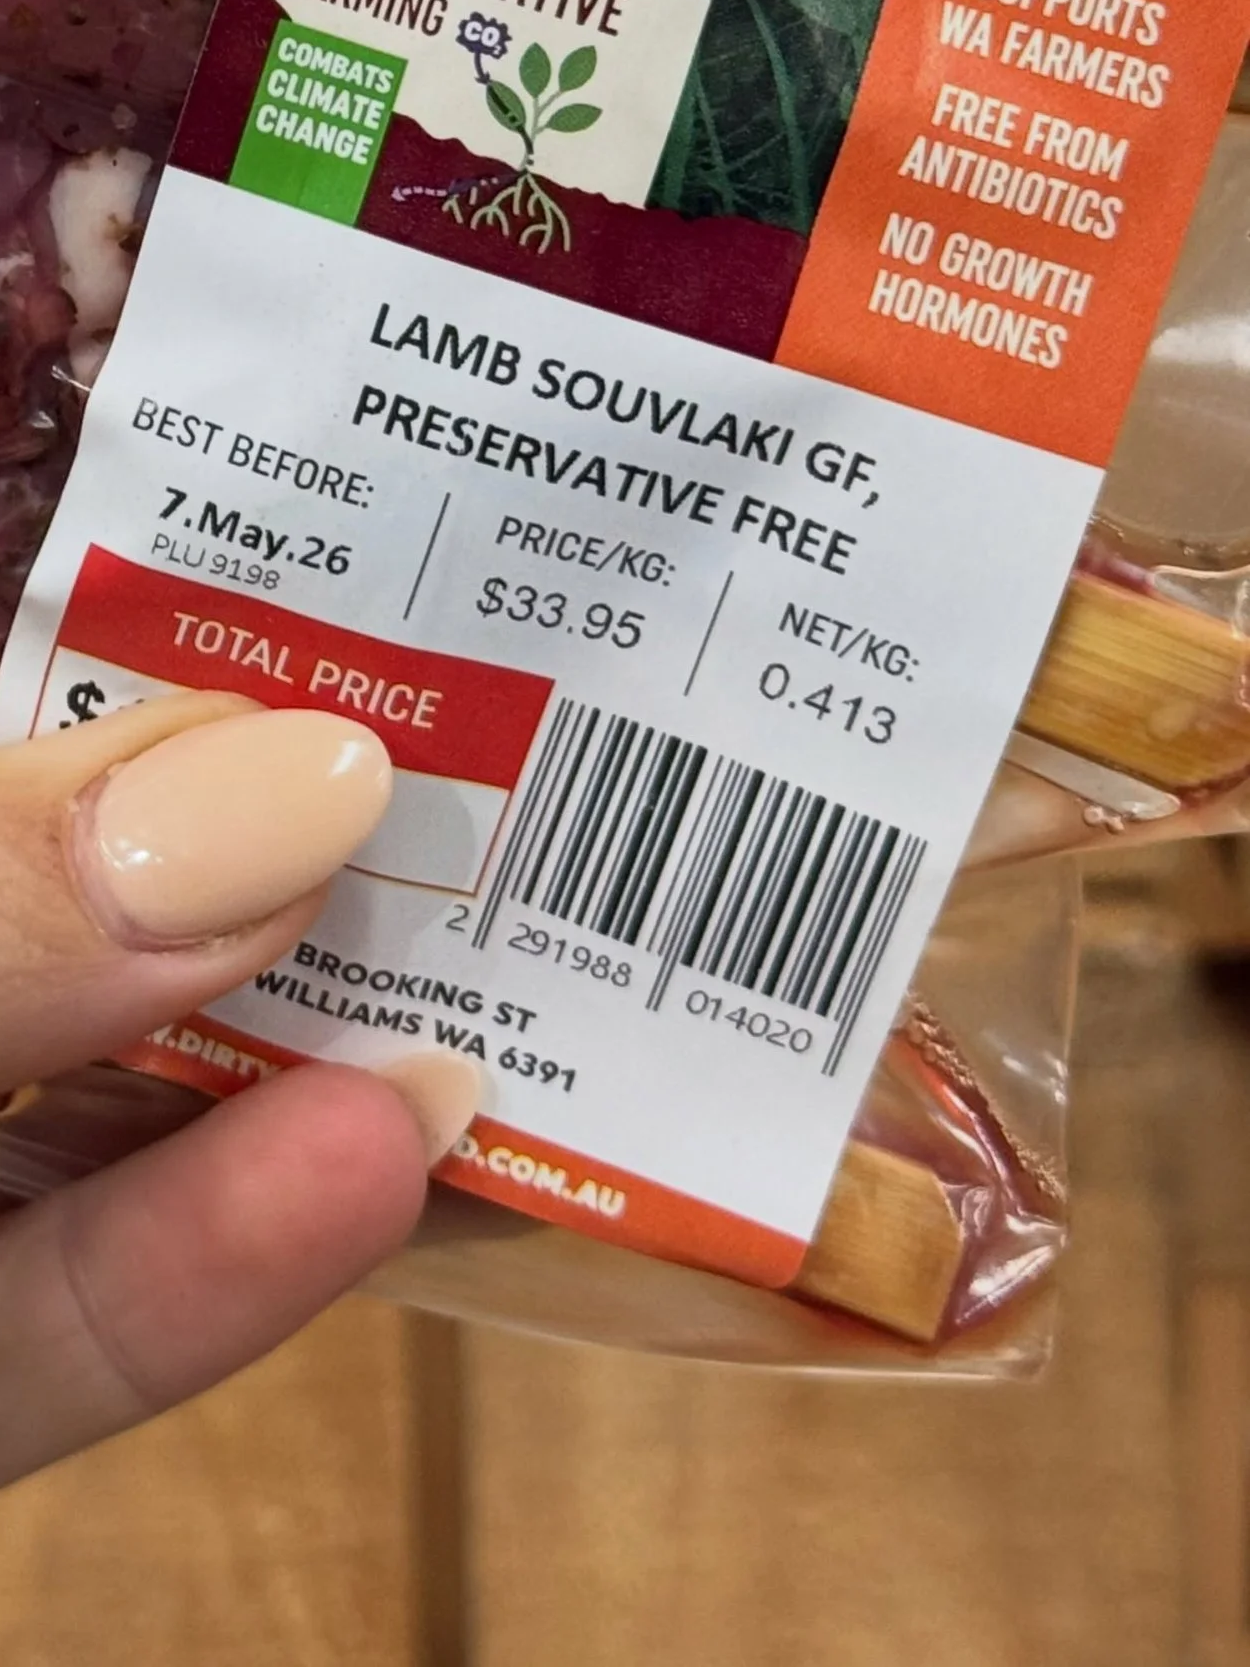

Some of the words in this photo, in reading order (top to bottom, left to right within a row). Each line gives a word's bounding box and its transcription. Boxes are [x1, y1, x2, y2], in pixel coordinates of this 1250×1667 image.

[267, 69, 385, 129] CLIMATE
[278, 37, 394, 94] COMBATS
[939, 0, 993, 58] WA
[1000, 22, 1172, 109] FARMERS
[255, 105, 374, 166] CHANGE
[931, 83, 1021, 149] FREE
[1023, 112, 1129, 181] FROM
[898, 136, 1124, 240] ANTIBIOTICS
[878, 212, 935, 266] NO
[939, 232, 1093, 317] GROWTH
[868, 270, 1068, 369] HORMONES
[132, 397, 223, 456] BEST
[227, 432, 375, 509] BEFORE:
[370, 302, 522, 387] LAMB
[531, 359, 795, 467] SOUVLAKI
[805, 440, 880, 509] GF,
[352, 384, 725, 525] PRESERVATIVE
[731, 494, 857, 576] FREE
[151, 533, 206, 569] PLU
[209, 551, 281, 591] 9198
[157, 486, 353, 577] 7.May.26
[495, 515, 676, 588] PRICE/KG:
[476, 576, 646, 650] $33.95
[778, 602, 921, 683] NET/KG:
[173, 611, 295, 685] TOTAL
[308, 658, 443, 730] PRICE
[759, 662, 897, 745] 0.413
[293, 941, 484, 1015] BROOKING
[493, 1001, 537, 1034] ST
[446, 903, 471, 933] 2
[508, 922, 633, 988] 291988
[685, 989, 814, 1055] 014020
[255, 971, 423, 1036] WILLIAMS
[434, 1018, 487, 1061] WA
[497, 1046, 578, 1093] 6391
